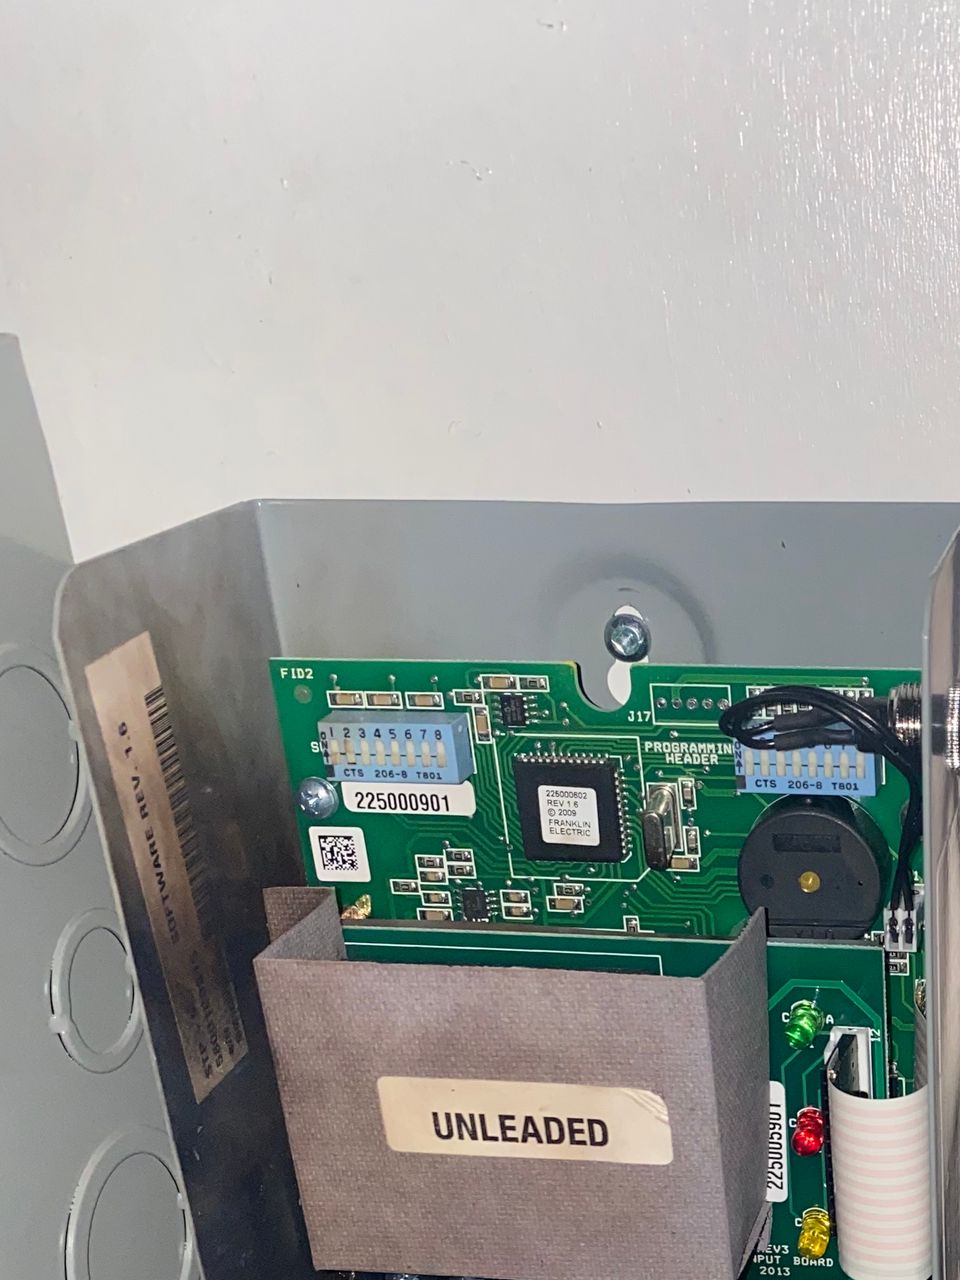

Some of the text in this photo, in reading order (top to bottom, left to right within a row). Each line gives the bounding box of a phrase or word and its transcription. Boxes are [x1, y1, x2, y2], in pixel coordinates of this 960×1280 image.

[281, 667, 314, 679] FID2
[628, 711, 651, 722] J17
[644, 741, 735, 754] PROGRAMMIN
[665, 754, 719, 765] HEADER
[343, 769, 443, 780] CTS 206-8 T801
[755, 779, 859, 791] CTS 206-8 T801
[355, 791, 450, 812] 225000901
[547, 799, 564, 807] REV
[558, 808, 577, 816] 2009
[549, 818, 591, 828] FRANKLIN
[549, 826, 591, 837] ELECTRIC
[145, 826, 180, 946] SOFTWARE
[826, 1014, 834, 1025] A
[432, 1110, 609, 1148] UNLEADED
[753, 1254, 834, 1267] PUT BOARD
[760, 1266, 791, 1276] 2013
